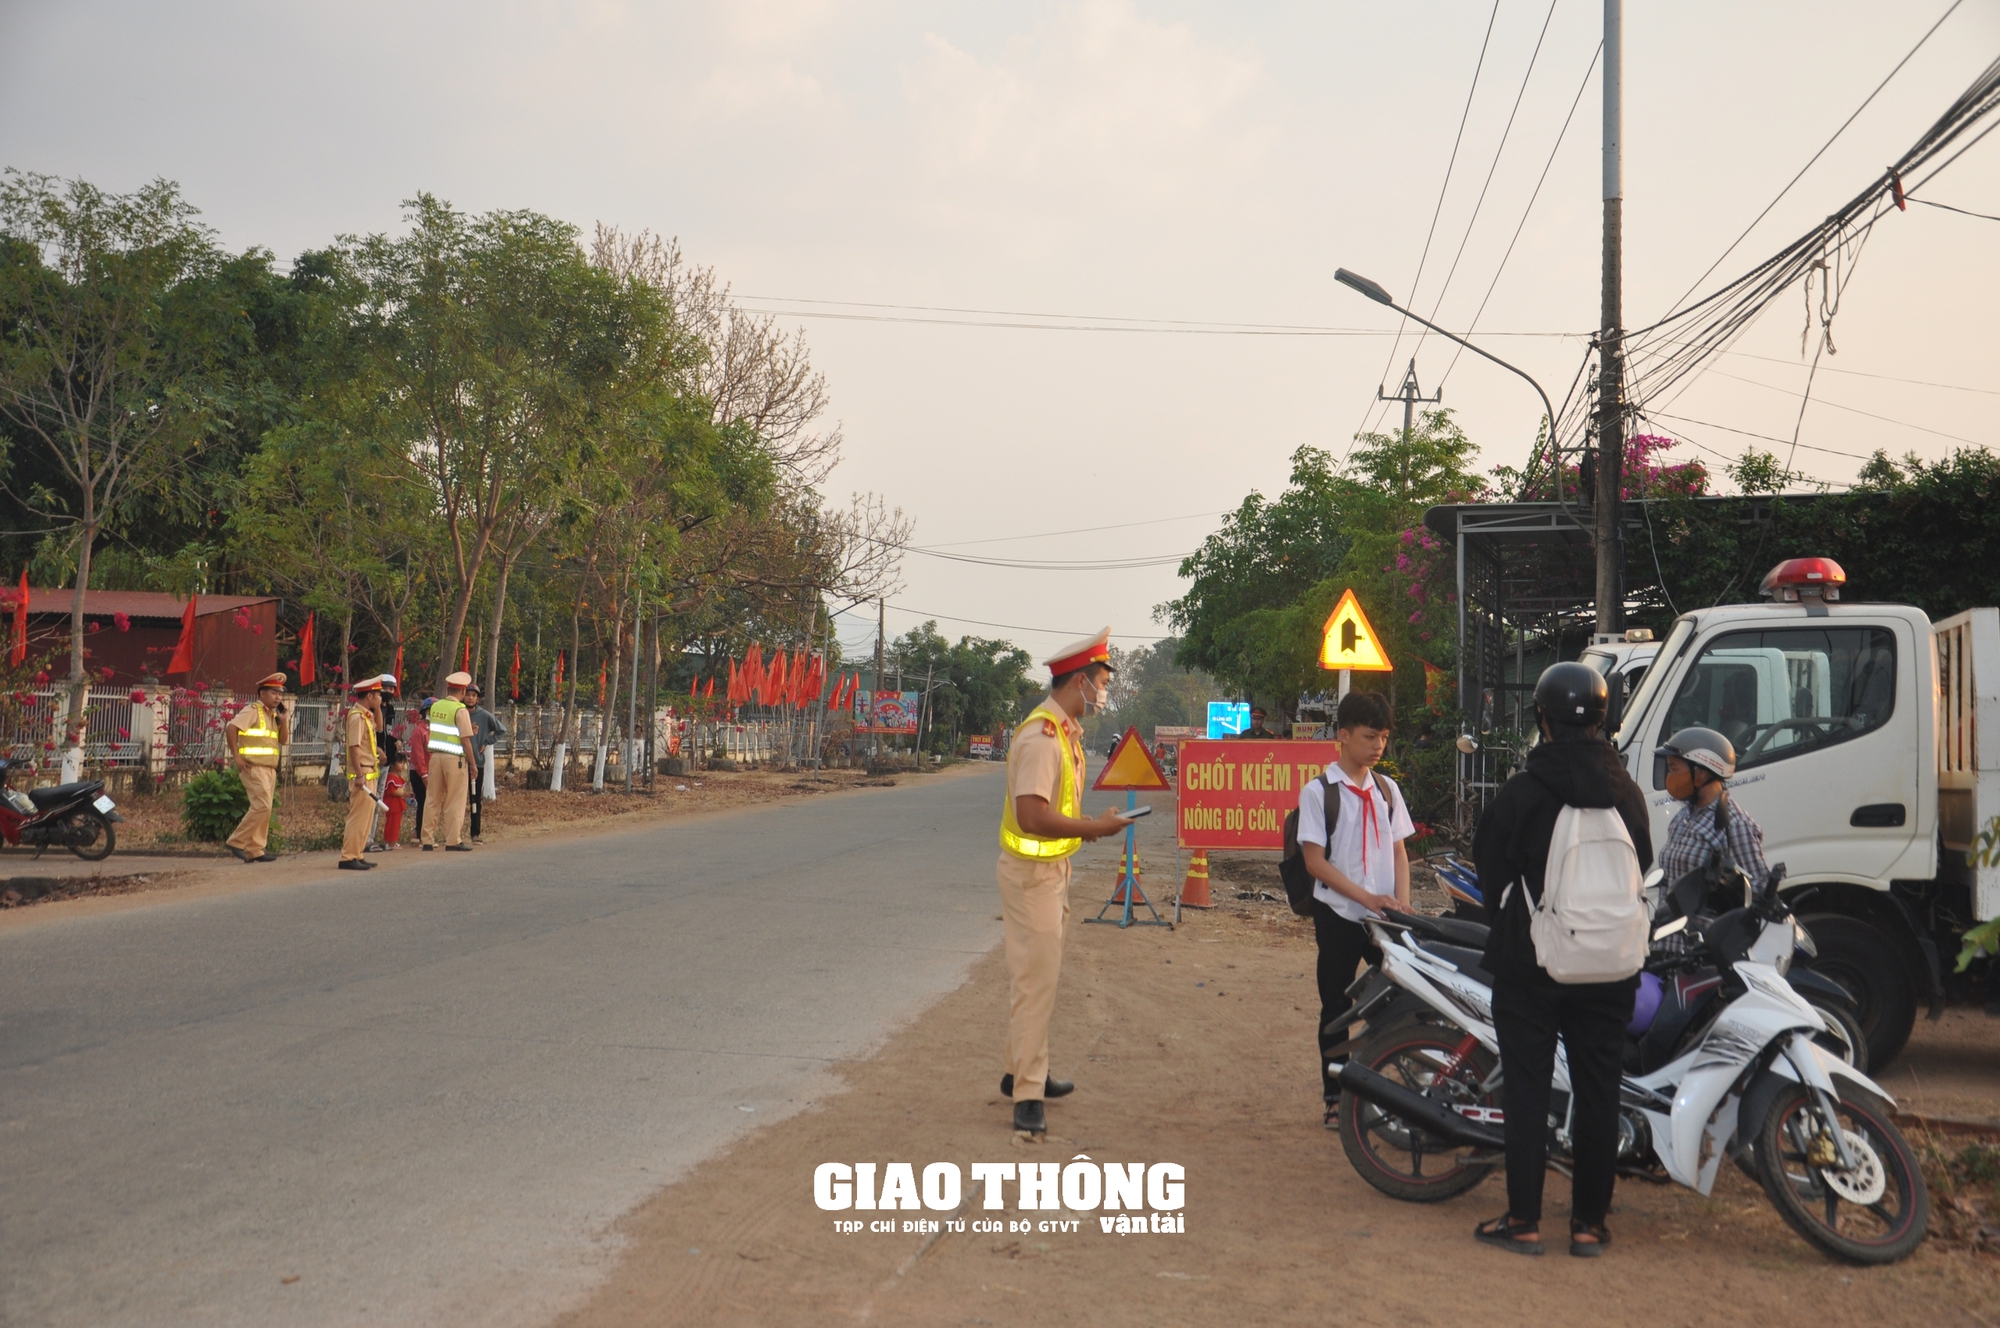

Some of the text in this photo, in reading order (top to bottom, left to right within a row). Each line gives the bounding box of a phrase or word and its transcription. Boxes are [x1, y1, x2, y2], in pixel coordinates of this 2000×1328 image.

[1186, 753, 1236, 791] CHỐT
[1241, 752, 1291, 791] KIỂM
[1184, 800, 1281, 836] NỒNG ĐỘ CỒN,
